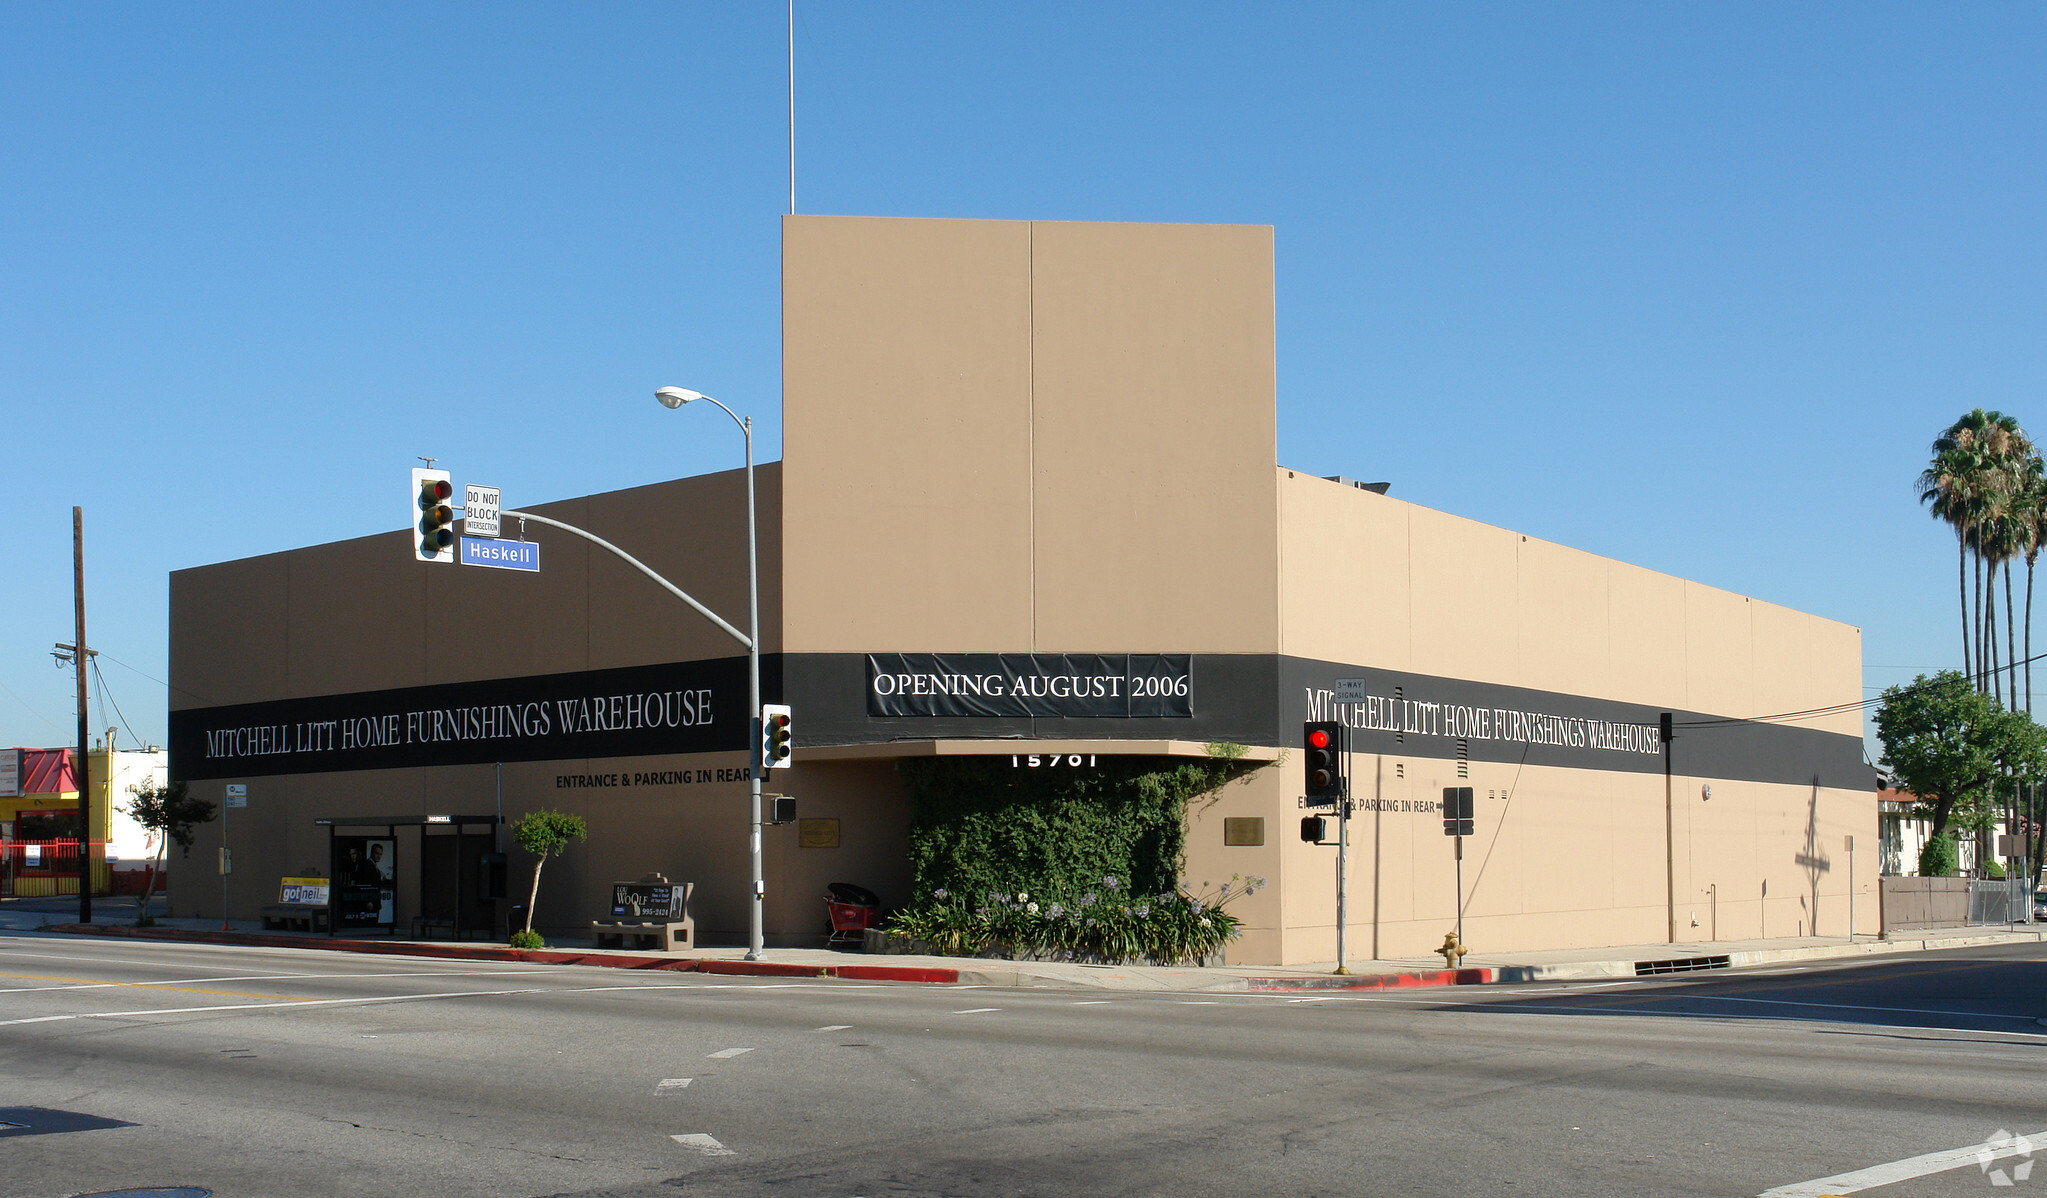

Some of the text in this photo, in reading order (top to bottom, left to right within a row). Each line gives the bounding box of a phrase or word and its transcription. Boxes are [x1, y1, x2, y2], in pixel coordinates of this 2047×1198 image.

[467, 491, 498, 505] DO NOT
[467, 506, 498, 520] BLOCK
[467, 521, 497, 531] INTERSECTION
[470, 542, 530, 563] Haskell
[873, 673, 1188, 698] OPENING AUGUST 2006
[1337, 681, 1362, 689] 3-WAY
[205, 689, 714, 758] MITCHELL LITT HOME FURNISHINGS WAREHOUSE
[1402, 700, 1440, 736] LITT
[1444, 704, 1491, 740] HOME
[1493, 708, 1585, 748] FURNISHINGS
[1587, 719, 1660, 755] WAREHOUSE
[1012, 753, 1096, 768] 15701
[556, 767, 751, 788] ENTRANCE & PARKING IN REAR
[1359, 798, 1399, 812] PARKING
[1401, 800, 1412, 812] IN
[1414, 800, 1435, 813] REAR
[282, 886, 301, 902] got
[302, 887, 320, 900] neil
